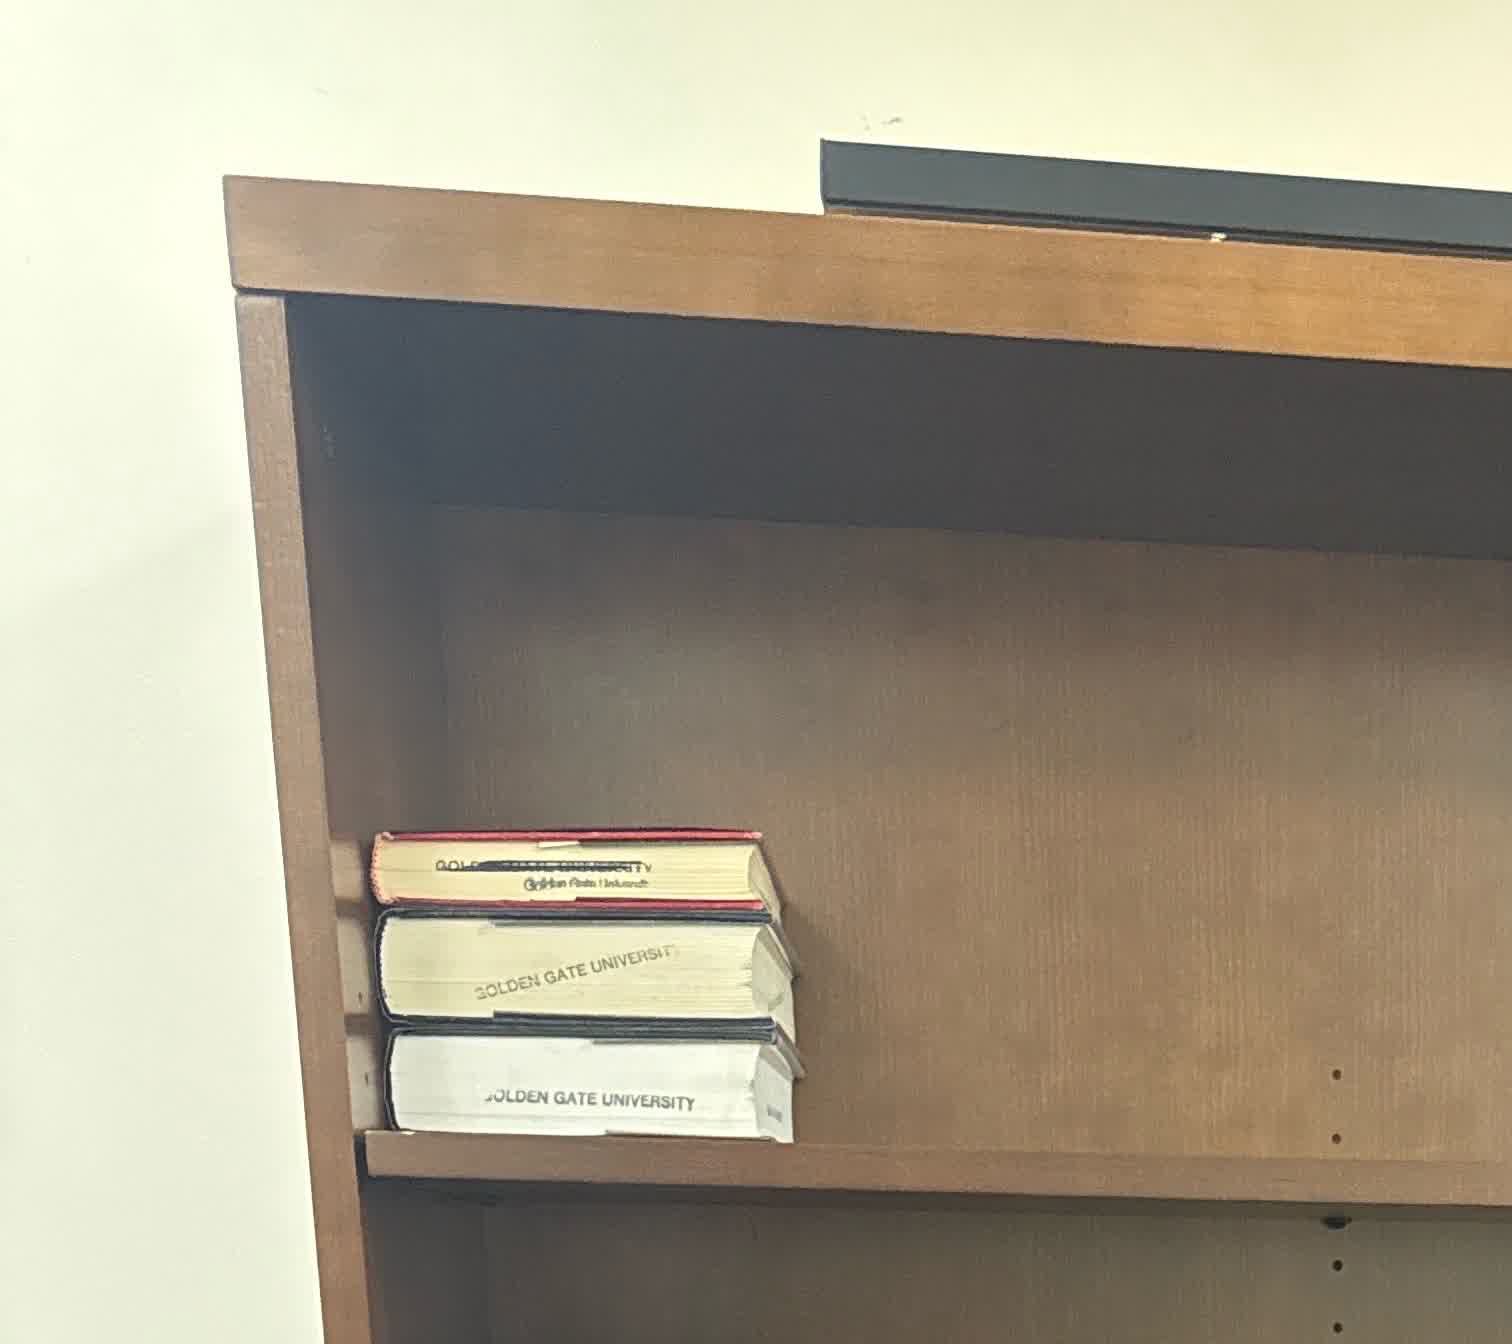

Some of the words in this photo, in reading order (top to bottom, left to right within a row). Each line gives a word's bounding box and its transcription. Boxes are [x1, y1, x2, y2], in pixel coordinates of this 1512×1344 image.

[543, 962, 588, 985] GATE
[484, 1088, 549, 1105] OLDEN
[553, 1090, 598, 1107] GATE
[602, 1092, 695, 1112] UNIVERSITY
